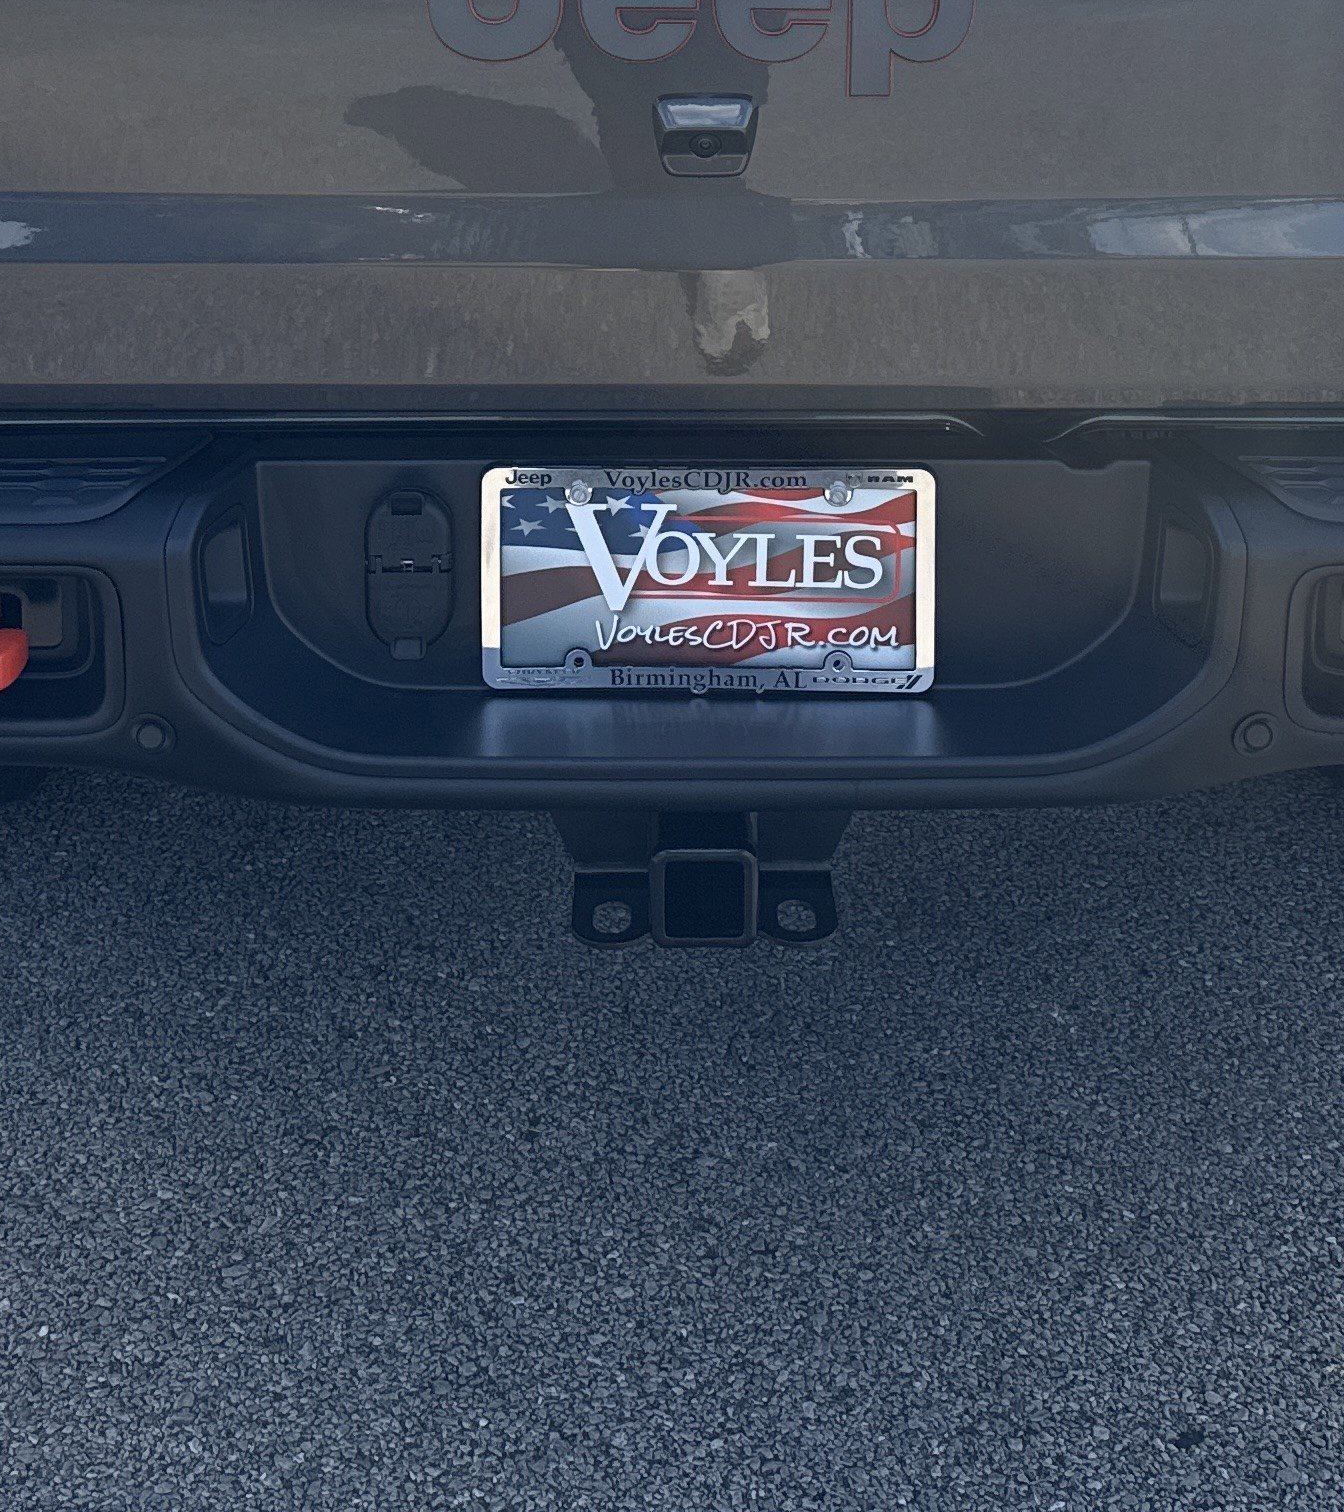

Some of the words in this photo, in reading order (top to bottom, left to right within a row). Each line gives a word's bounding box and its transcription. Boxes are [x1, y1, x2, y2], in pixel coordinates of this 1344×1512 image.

[504, 467, 553, 486] Jeep
[605, 471, 808, 494] VoylesCDJR.com
[565, 503, 883, 611] VOYLES
[773, 670, 807, 689] AL
